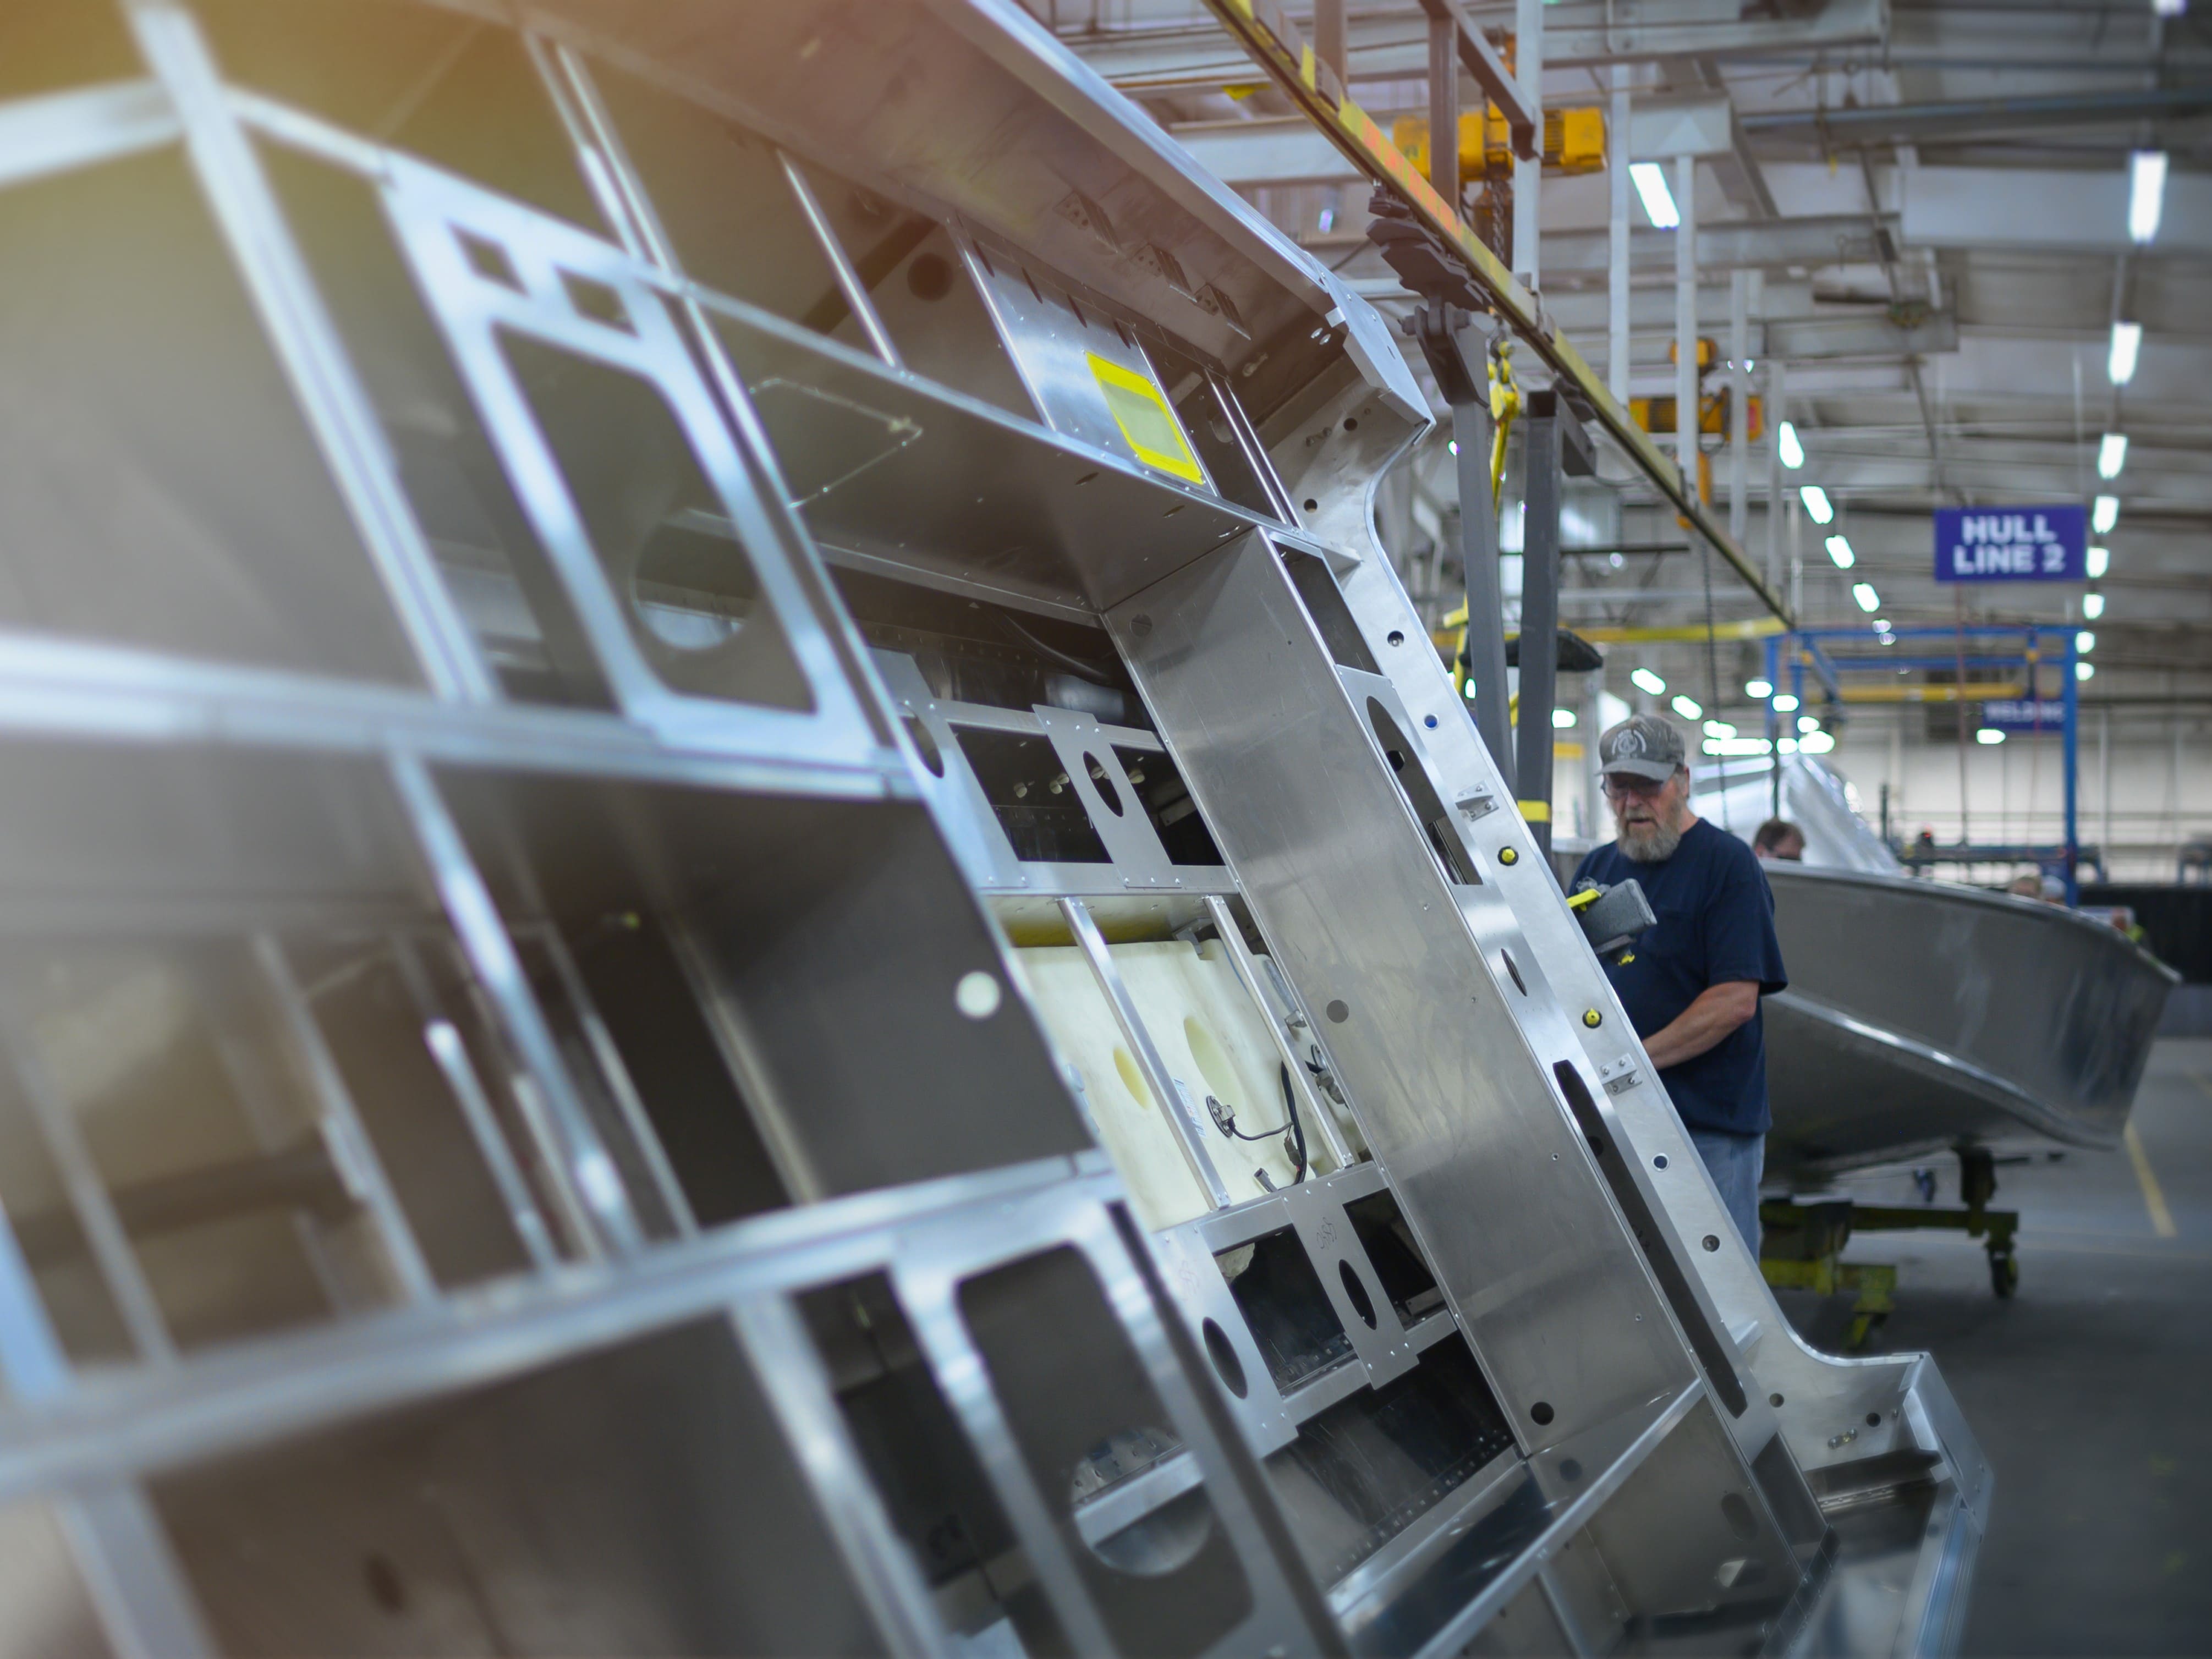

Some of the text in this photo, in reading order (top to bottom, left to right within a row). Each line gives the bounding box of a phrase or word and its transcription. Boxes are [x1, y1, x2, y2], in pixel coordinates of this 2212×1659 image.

[1962, 514, 2057, 544] HULL
[1954, 542, 2066, 574] LINE 2
[1985, 700, 2065, 723] WELDNG
